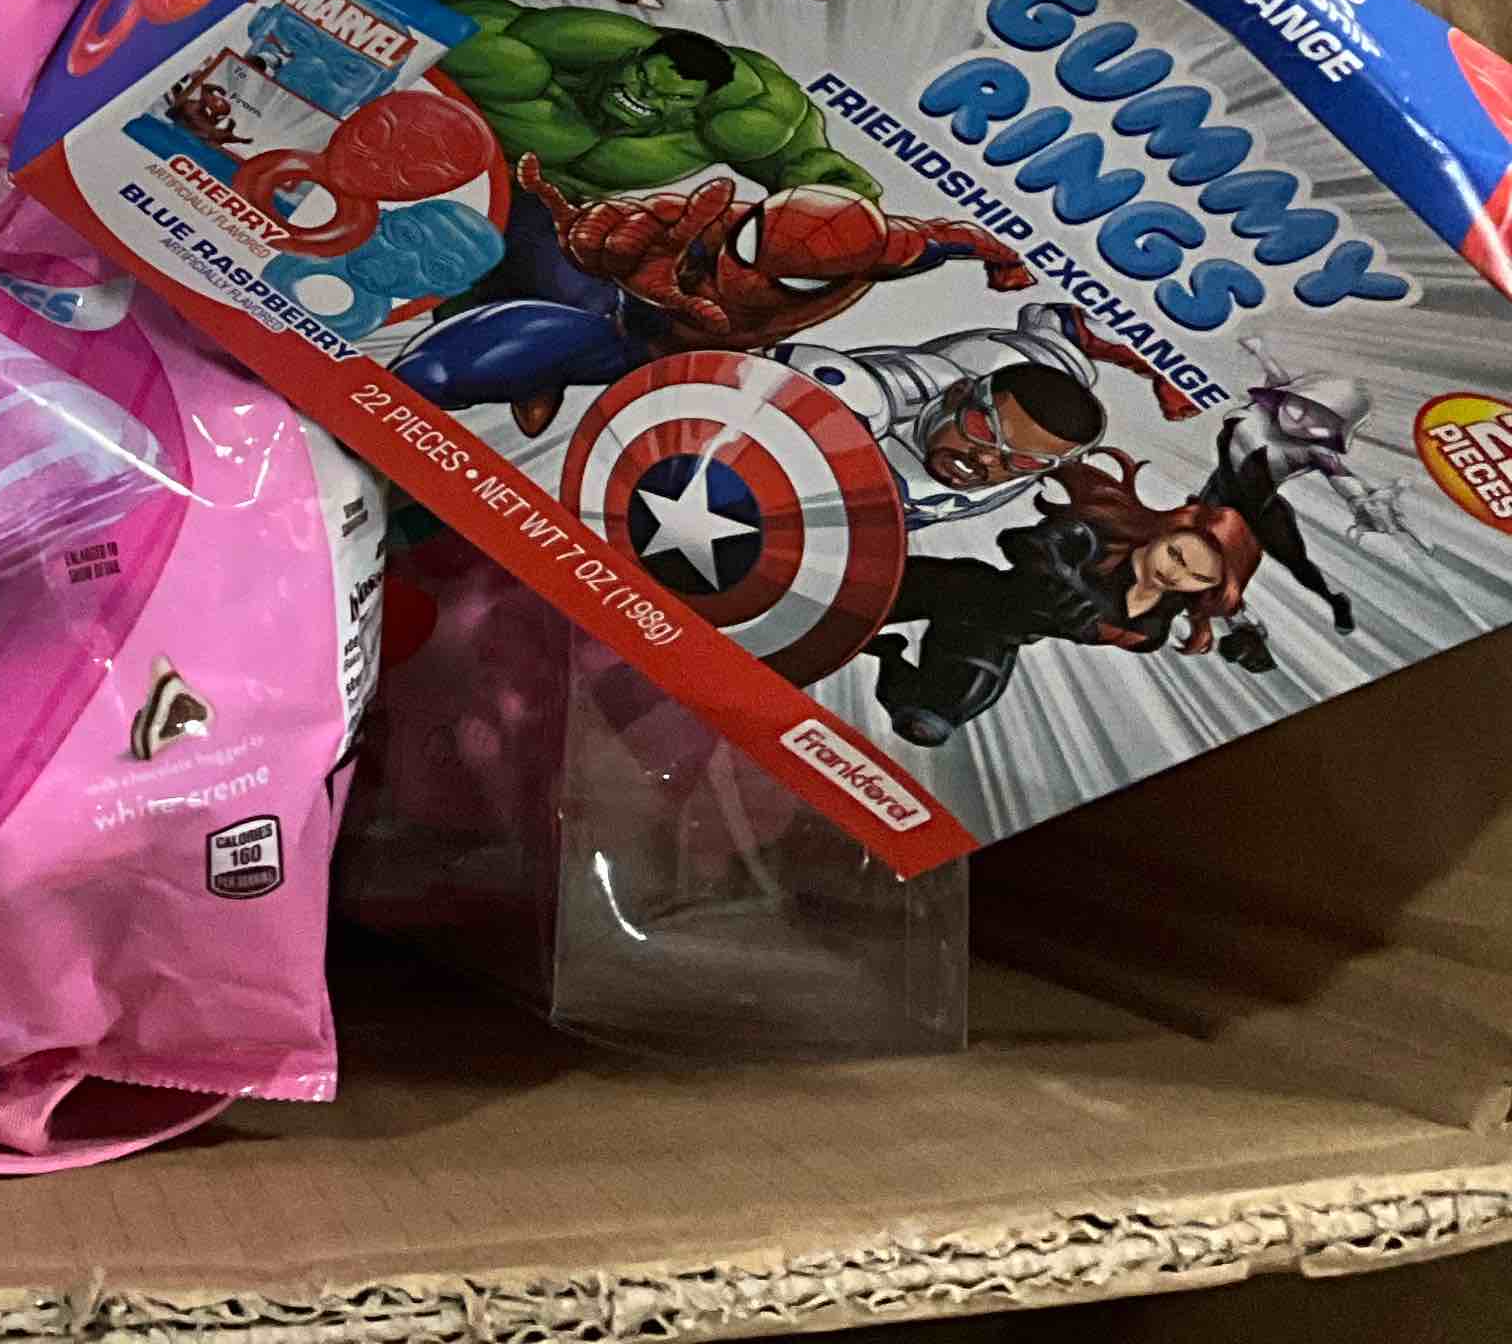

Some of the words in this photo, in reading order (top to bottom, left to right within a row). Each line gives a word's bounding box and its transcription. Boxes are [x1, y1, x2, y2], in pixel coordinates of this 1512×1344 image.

[145, 163, 216, 219] ARTIFICIALLY
[214, 212, 272, 260] FLAVORED
[169, 156, 285, 241] CHERRY
[806, 72, 1034, 243] FRIENDSHIP
[1025, 241, 1232, 411] EXCHANGE
[919, 57, 1266, 331] RINGS
[119, 184, 196, 241] BLUE
[191, 239, 361, 361] RASPBERRY
[161, 237, 230, 293] ARTIFICIALLY
[228, 287, 286, 332] FLAVORED
[350, 384, 392, 415] 22
[383, 405, 470, 472] PIECES
[472, 475, 532, 521] NET
[519, 512, 569, 548] WT
[556, 543, 586, 562] 7
[574, 558, 618, 592] OZ
[601, 586, 684, 647] (198g)
[1429, 423, 1512, 518] PIECES
[186, 765, 270, 808] creme
[792, 726, 920, 825] Frankford
[216, 824, 273, 849] CALORIES
[230, 845, 261, 867] 160
